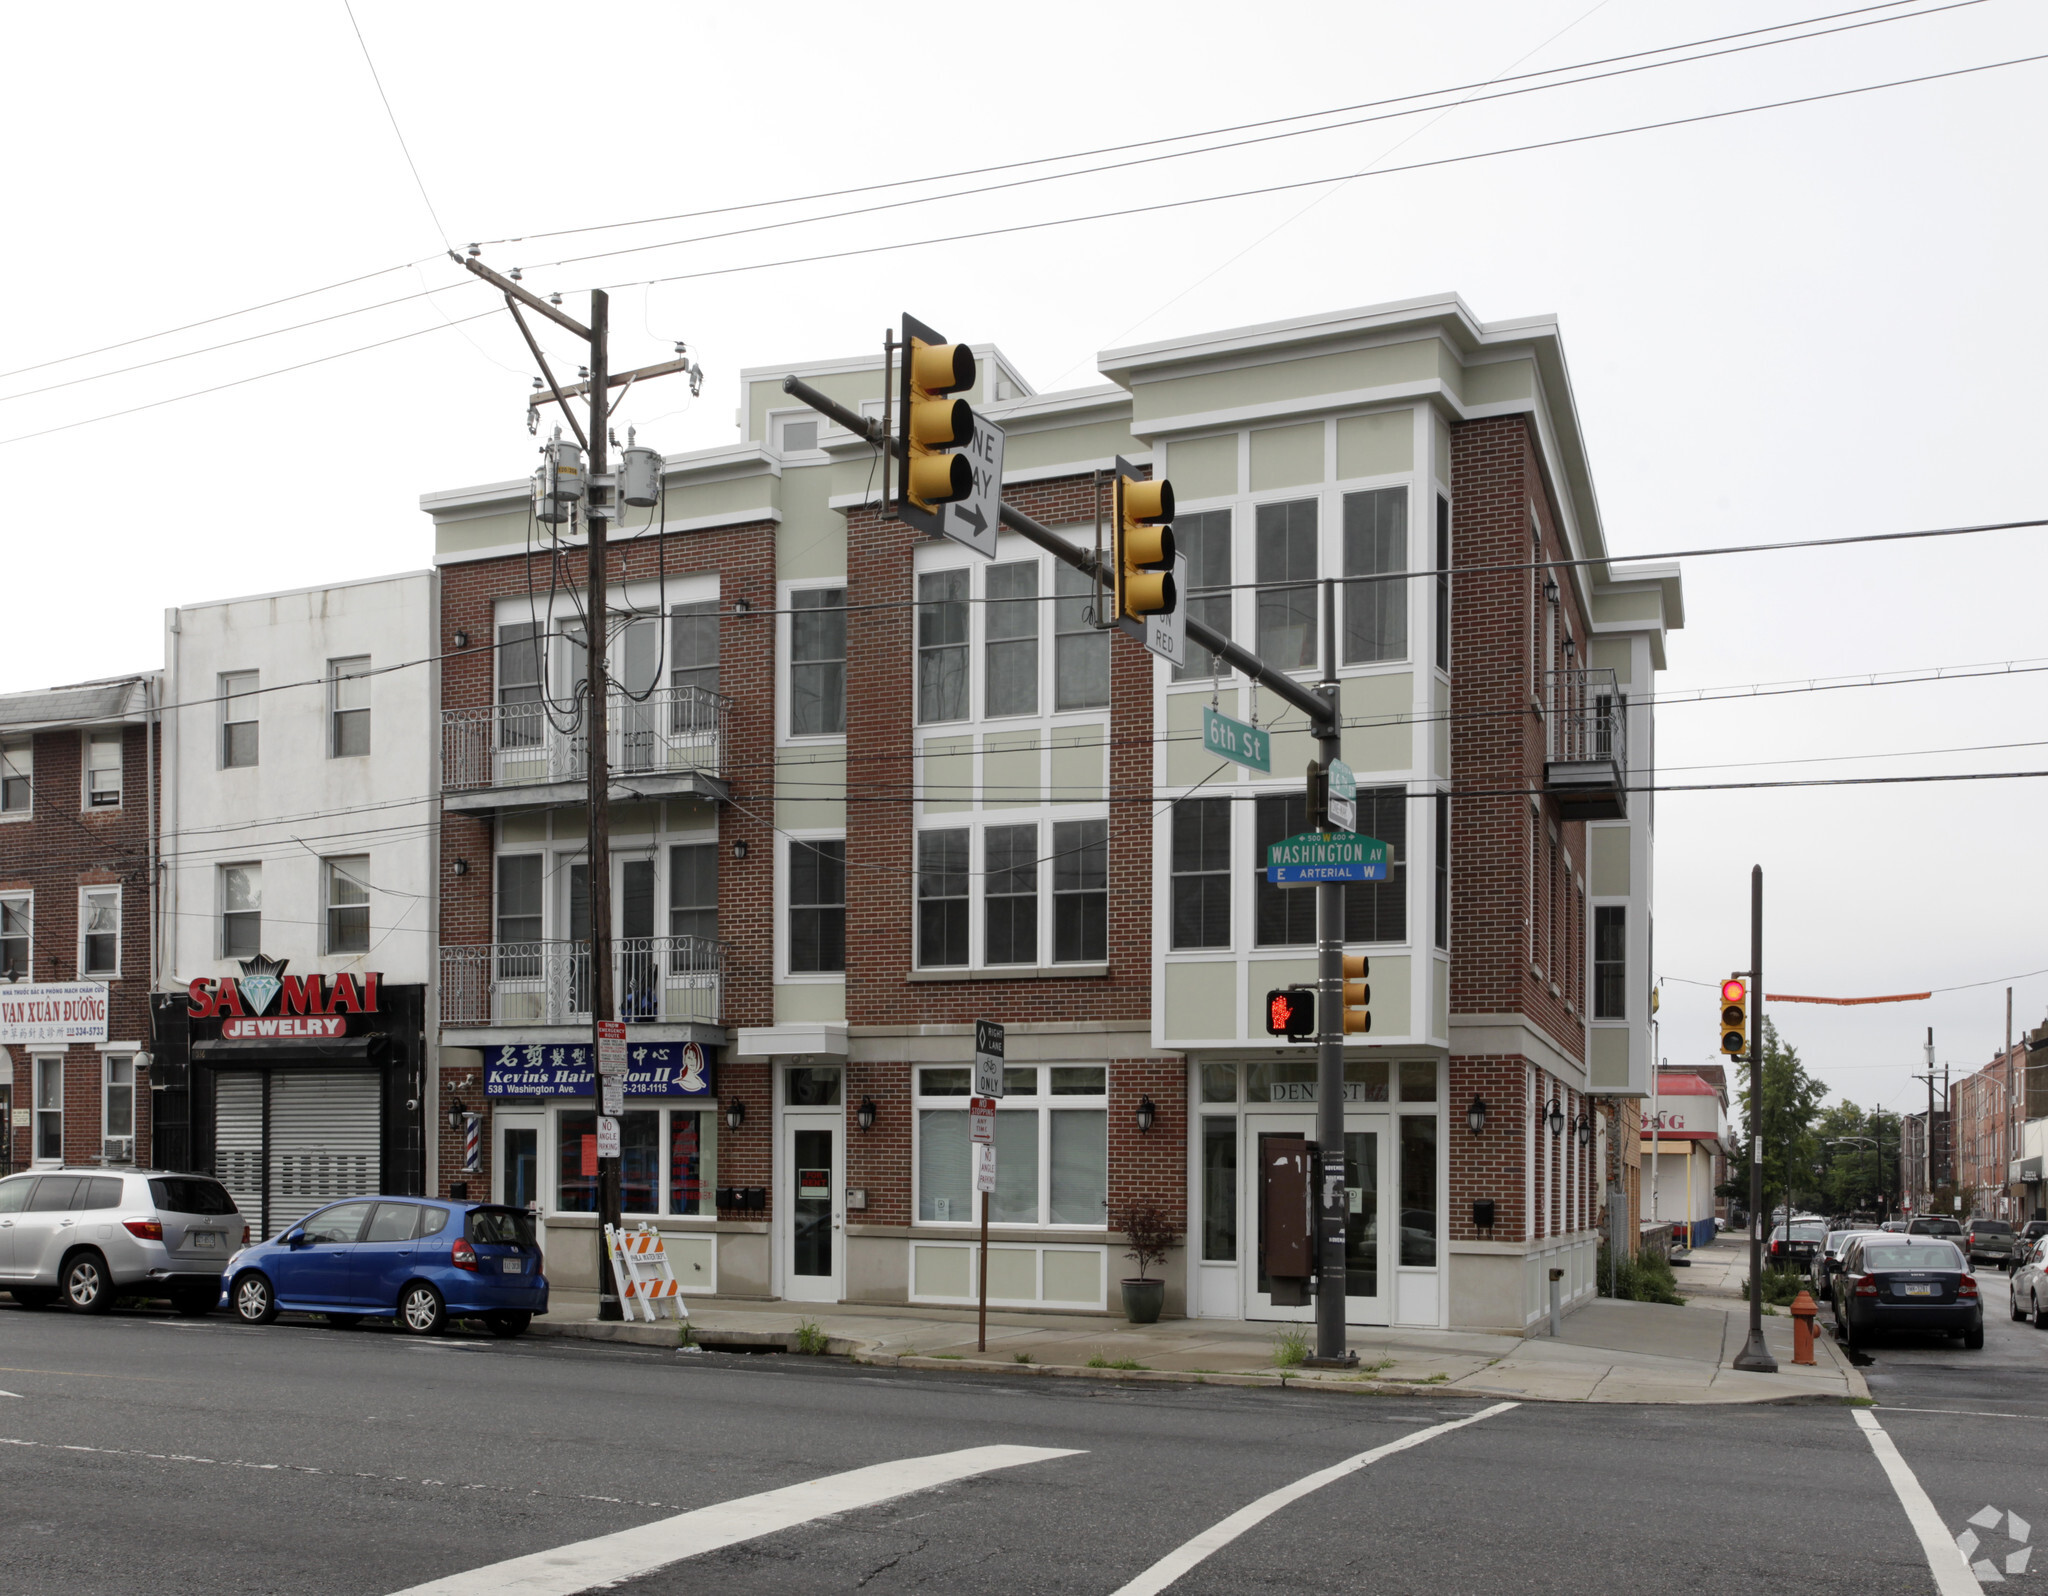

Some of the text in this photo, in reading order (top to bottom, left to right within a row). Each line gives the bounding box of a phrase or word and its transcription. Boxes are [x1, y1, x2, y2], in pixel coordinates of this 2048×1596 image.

[973, 426, 995, 464] NE
[972, 466, 993, 500] AY
[1156, 629, 1174, 653] RED
[1210, 718, 1261, 761] 6th St
[1323, 833, 1331, 842] W
[1272, 844, 1382, 864] WASHINGTON AV
[1277, 866, 1375, 880] E ARTERIAL W
[188, 972, 383, 1018] SA MAI
[229, 1018, 340, 1037] JEWELRY
[988, 1027, 1003, 1038] RIGHT
[988, 1041, 1002, 1052] LANE
[488, 1068, 549, 1083] Kevin's
[554, 1069, 595, 1083] Hair
[488, 1085, 503, 1093] 538
[507, 1084, 554, 1095] Washington
[558, 1084, 576, 1093] Ave.
[980, 1076, 998, 1092] ONLY
[979, 1099, 987, 1108] NO
[971, 1107, 994, 1116] STOPPING
[602, 1121, 612, 1131] NO
[985, 1151, 992, 1162] NO
[806, 1171, 822, 1179] FOR
[802, 1179, 827, 1187] RENT
